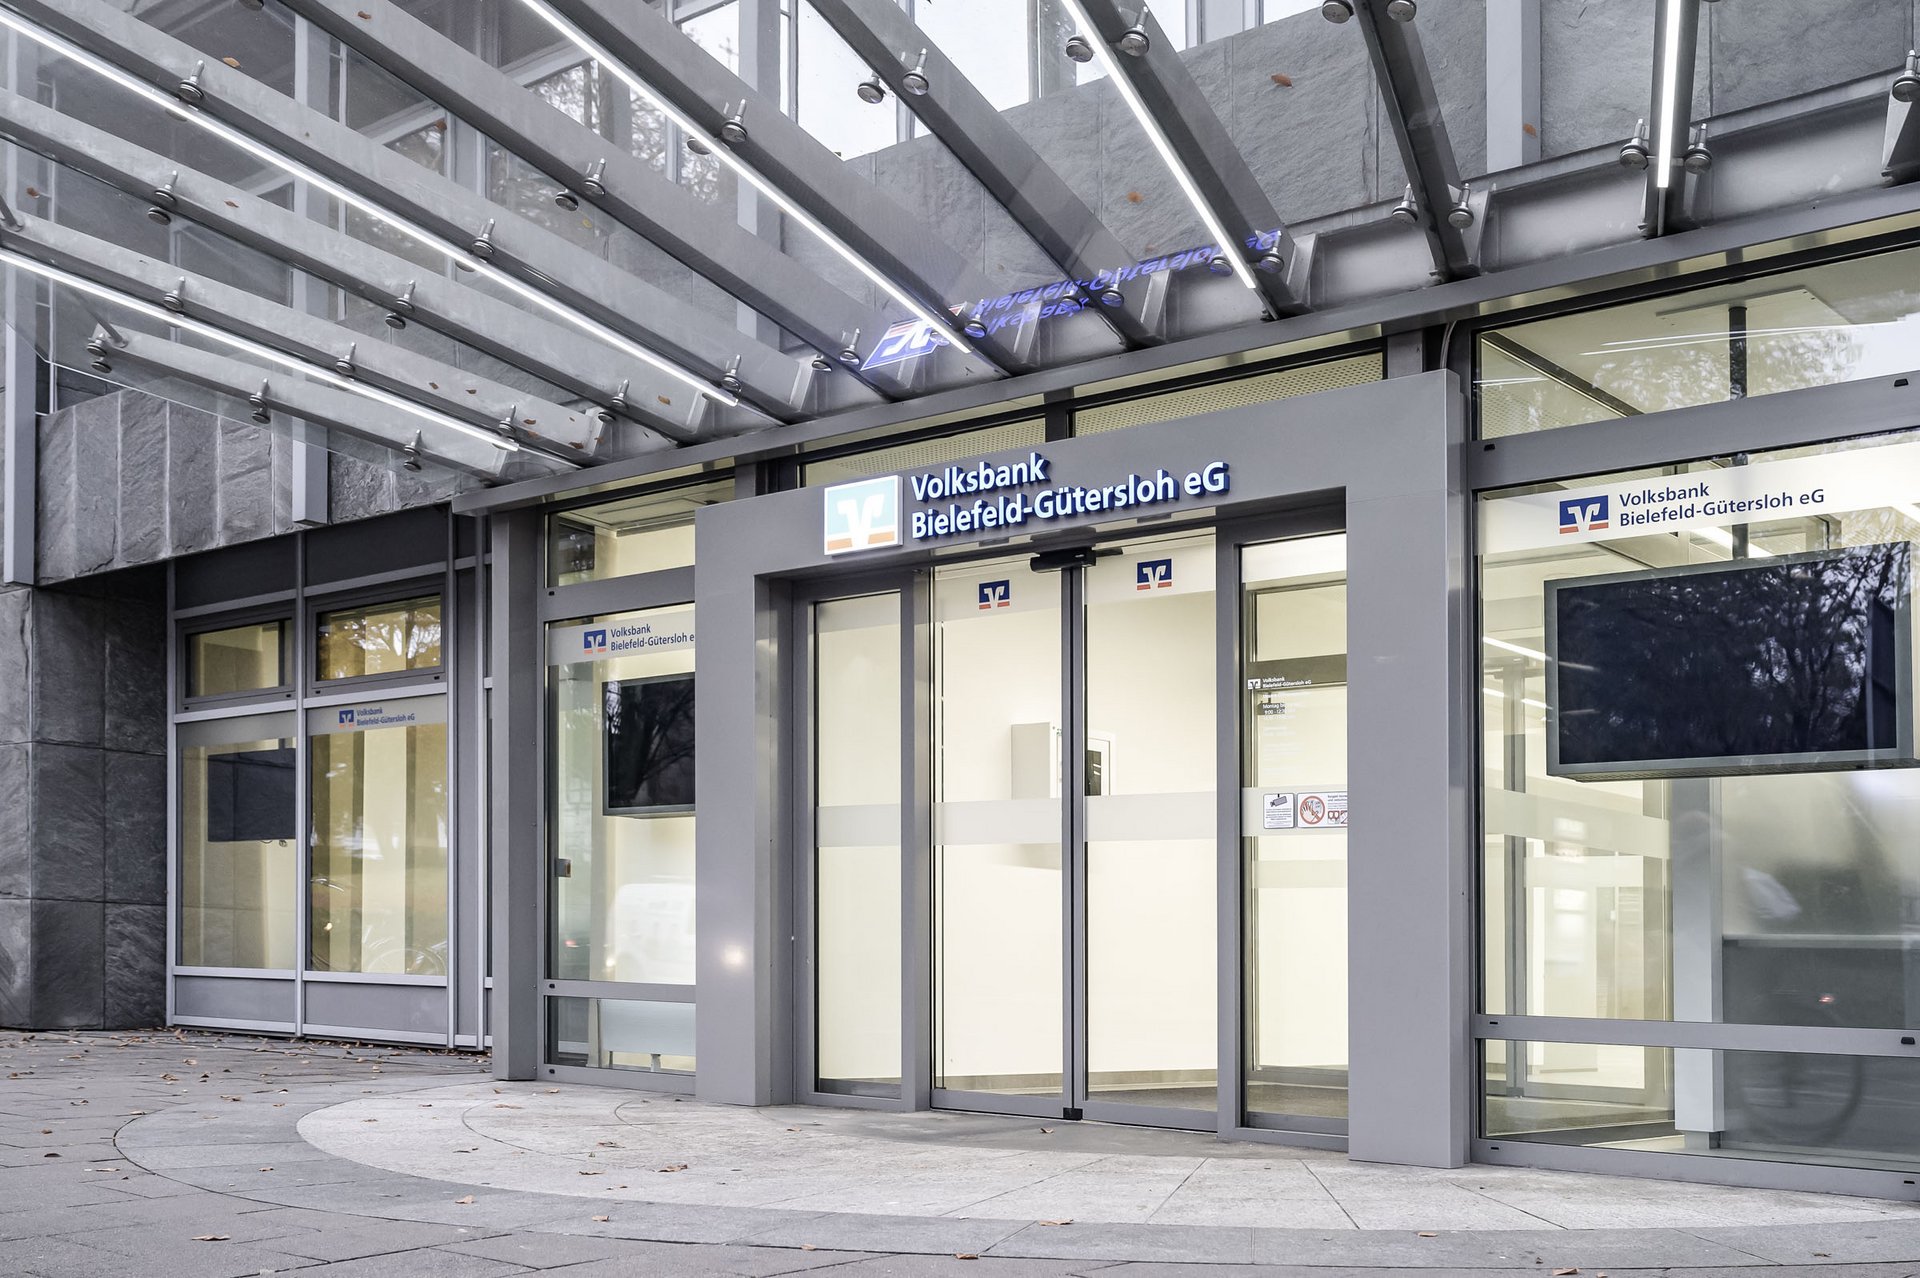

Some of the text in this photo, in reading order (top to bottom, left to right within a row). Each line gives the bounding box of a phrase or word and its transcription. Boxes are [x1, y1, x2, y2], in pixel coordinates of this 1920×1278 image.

[911, 452, 1048, 501] Volksbank
[911, 461, 1230, 539] Bielefeld-Gütersloh eG
[1619, 482, 1709, 507] Volksbank
[1620, 488, 1825, 527] Bielefeld-Gütersloh eG
[610, 633, 695, 651] Bielefeld-Gütersloh e
[611, 623, 651, 638] Volksbank
[356, 707, 383, 717] Volksbank
